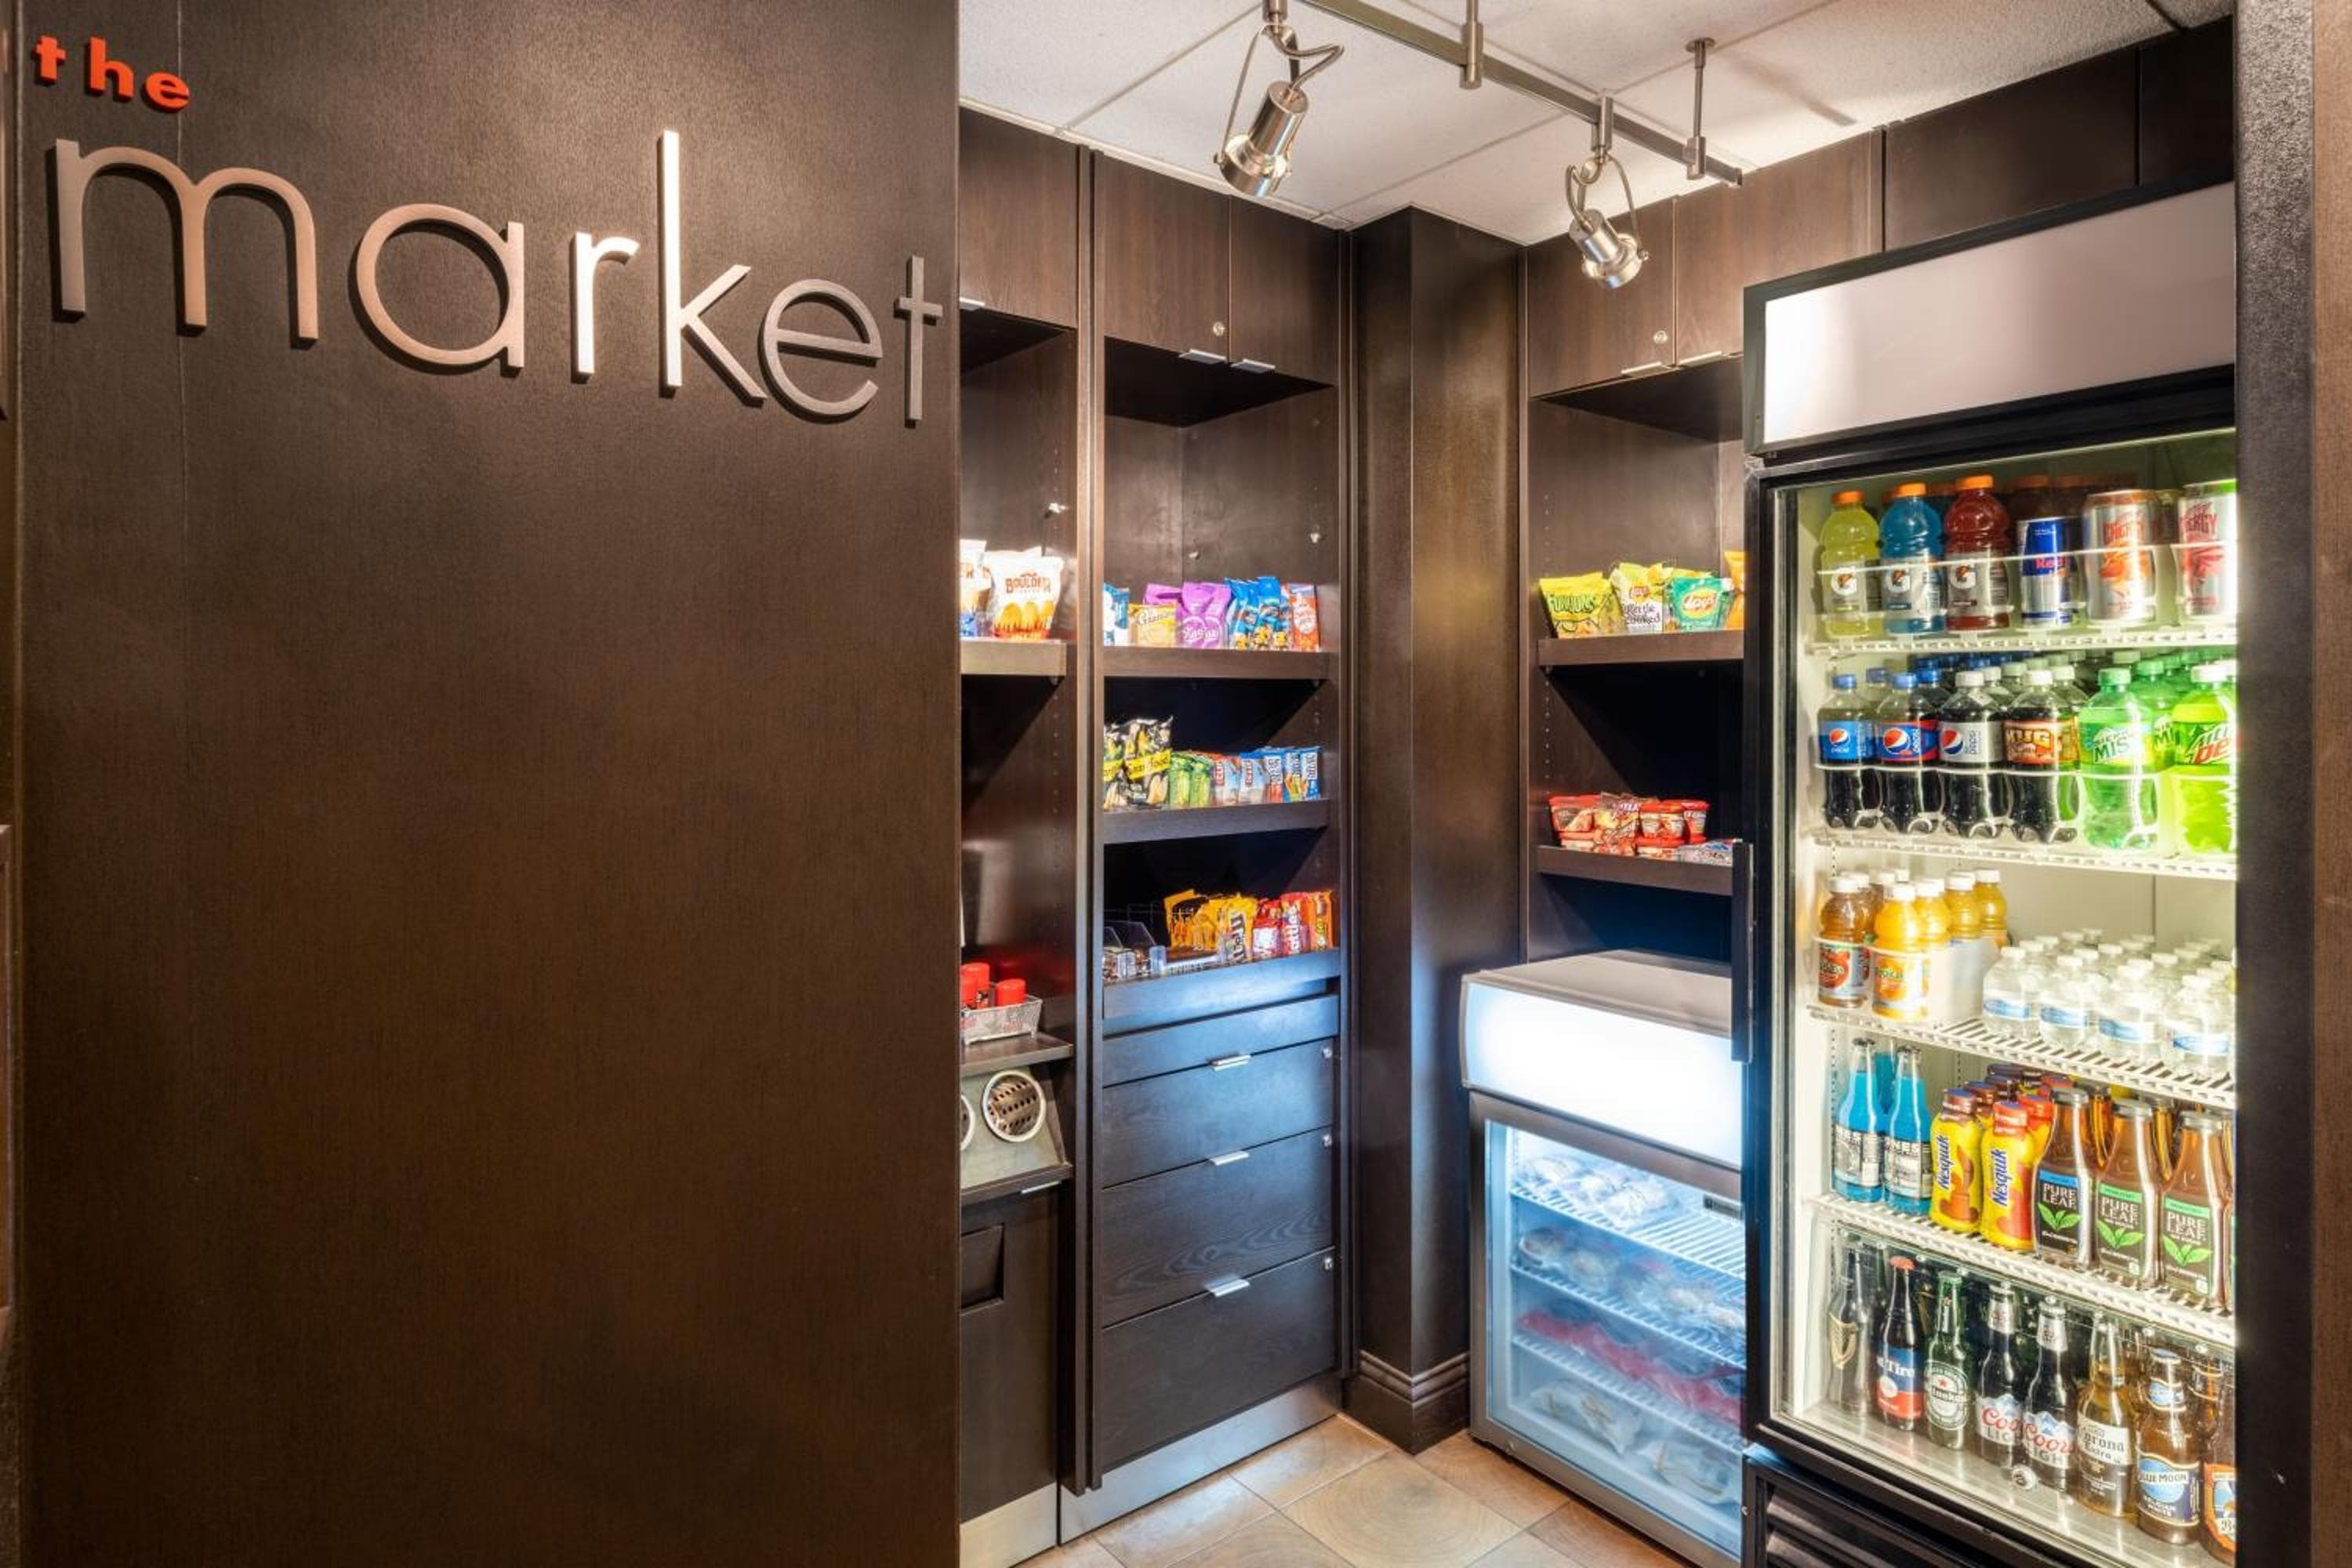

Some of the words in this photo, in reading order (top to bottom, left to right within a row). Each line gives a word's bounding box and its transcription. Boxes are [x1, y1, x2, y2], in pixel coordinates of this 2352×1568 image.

[33, 34, 190, 111] the
[53, 129, 943, 423] market
[1936, 1134, 1955, 1190] Nesquik
[1991, 1148, 2012, 1207] Nesquik
[2042, 1192, 2076, 1210] LEAF
[2043, 1182, 2078, 1200] PURE
[2101, 1196, 2140, 1214] PURE
[2101, 1206, 2138, 1225] LEAF
[2167, 1211, 2207, 1229] PURE
[2166, 1220, 2205, 1242] LEAF
[2083, 1432, 2125, 1453] orona
[2158, 1473, 2188, 1483] MOON
